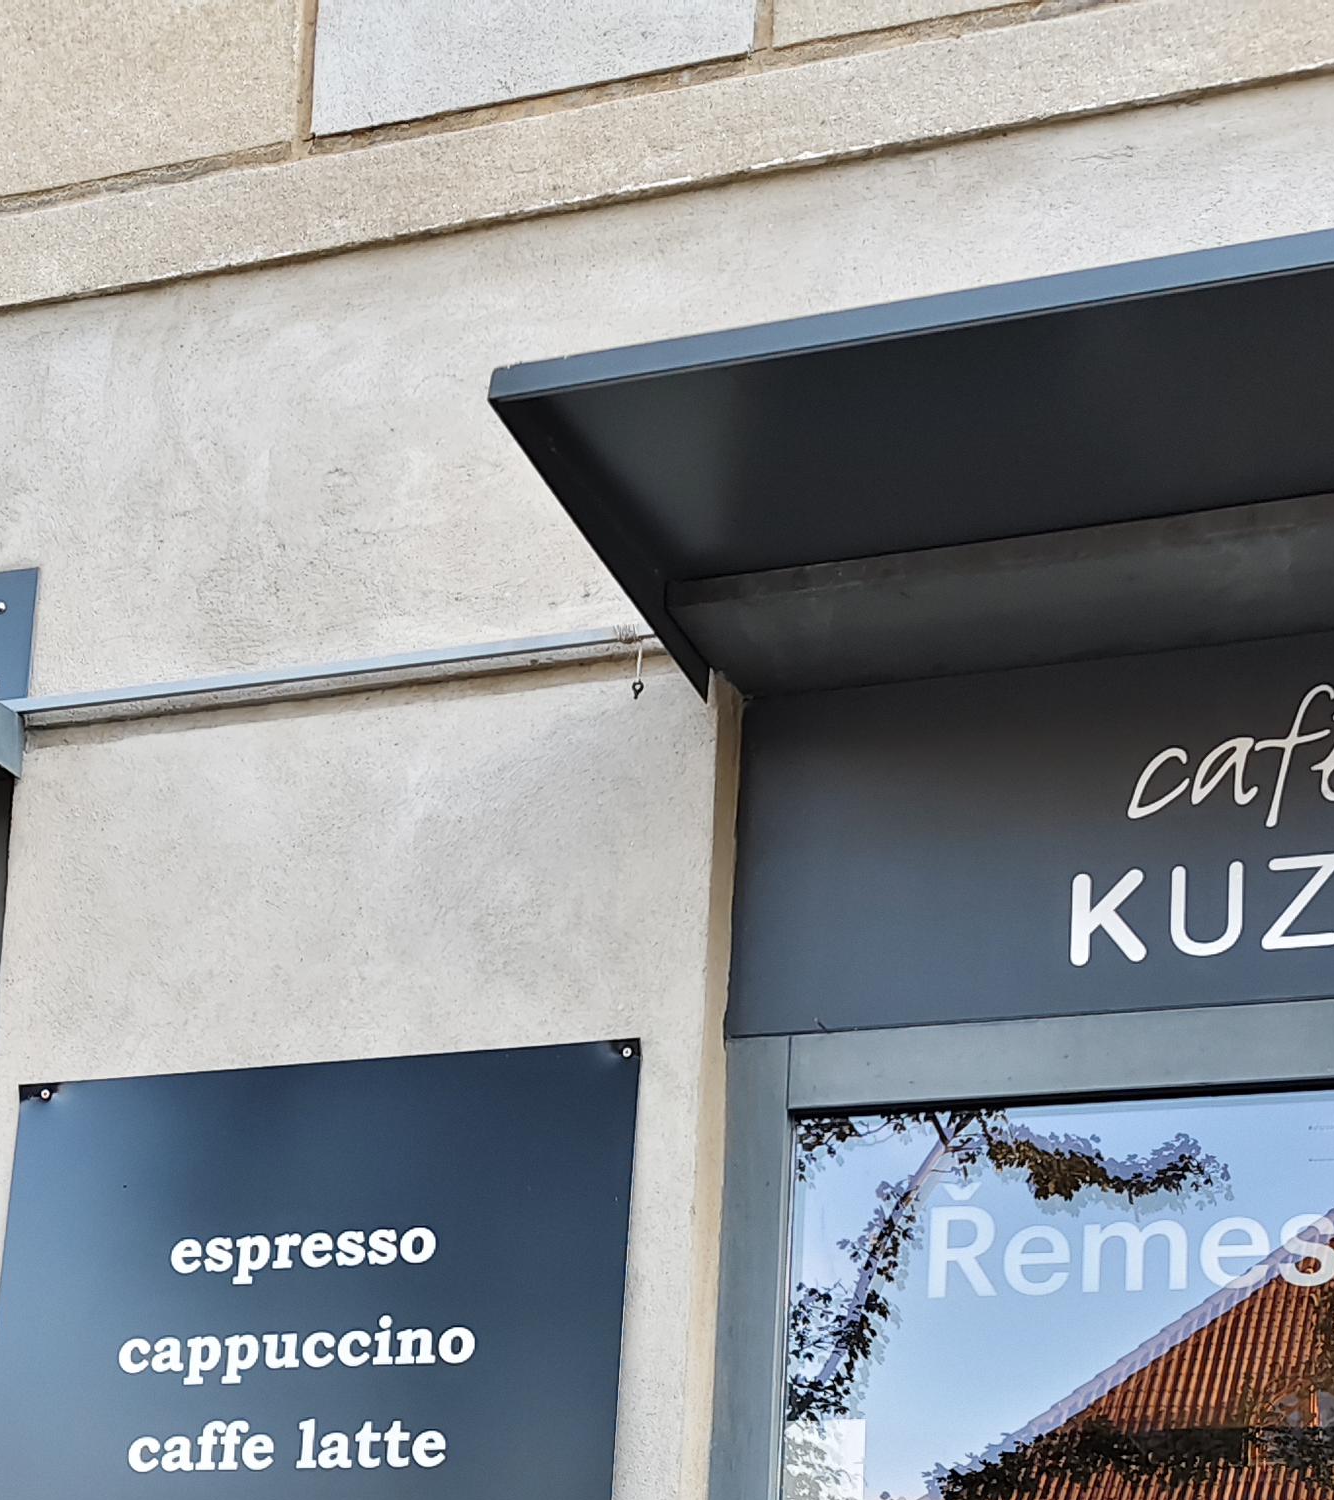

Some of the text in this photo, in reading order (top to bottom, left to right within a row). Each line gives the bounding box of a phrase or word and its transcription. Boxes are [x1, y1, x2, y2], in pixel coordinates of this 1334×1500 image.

[170, 1227, 437, 1285] espresso
[118, 1314, 476, 1386] cappuccino
[127, 1418, 447, 1473] caffe latte
